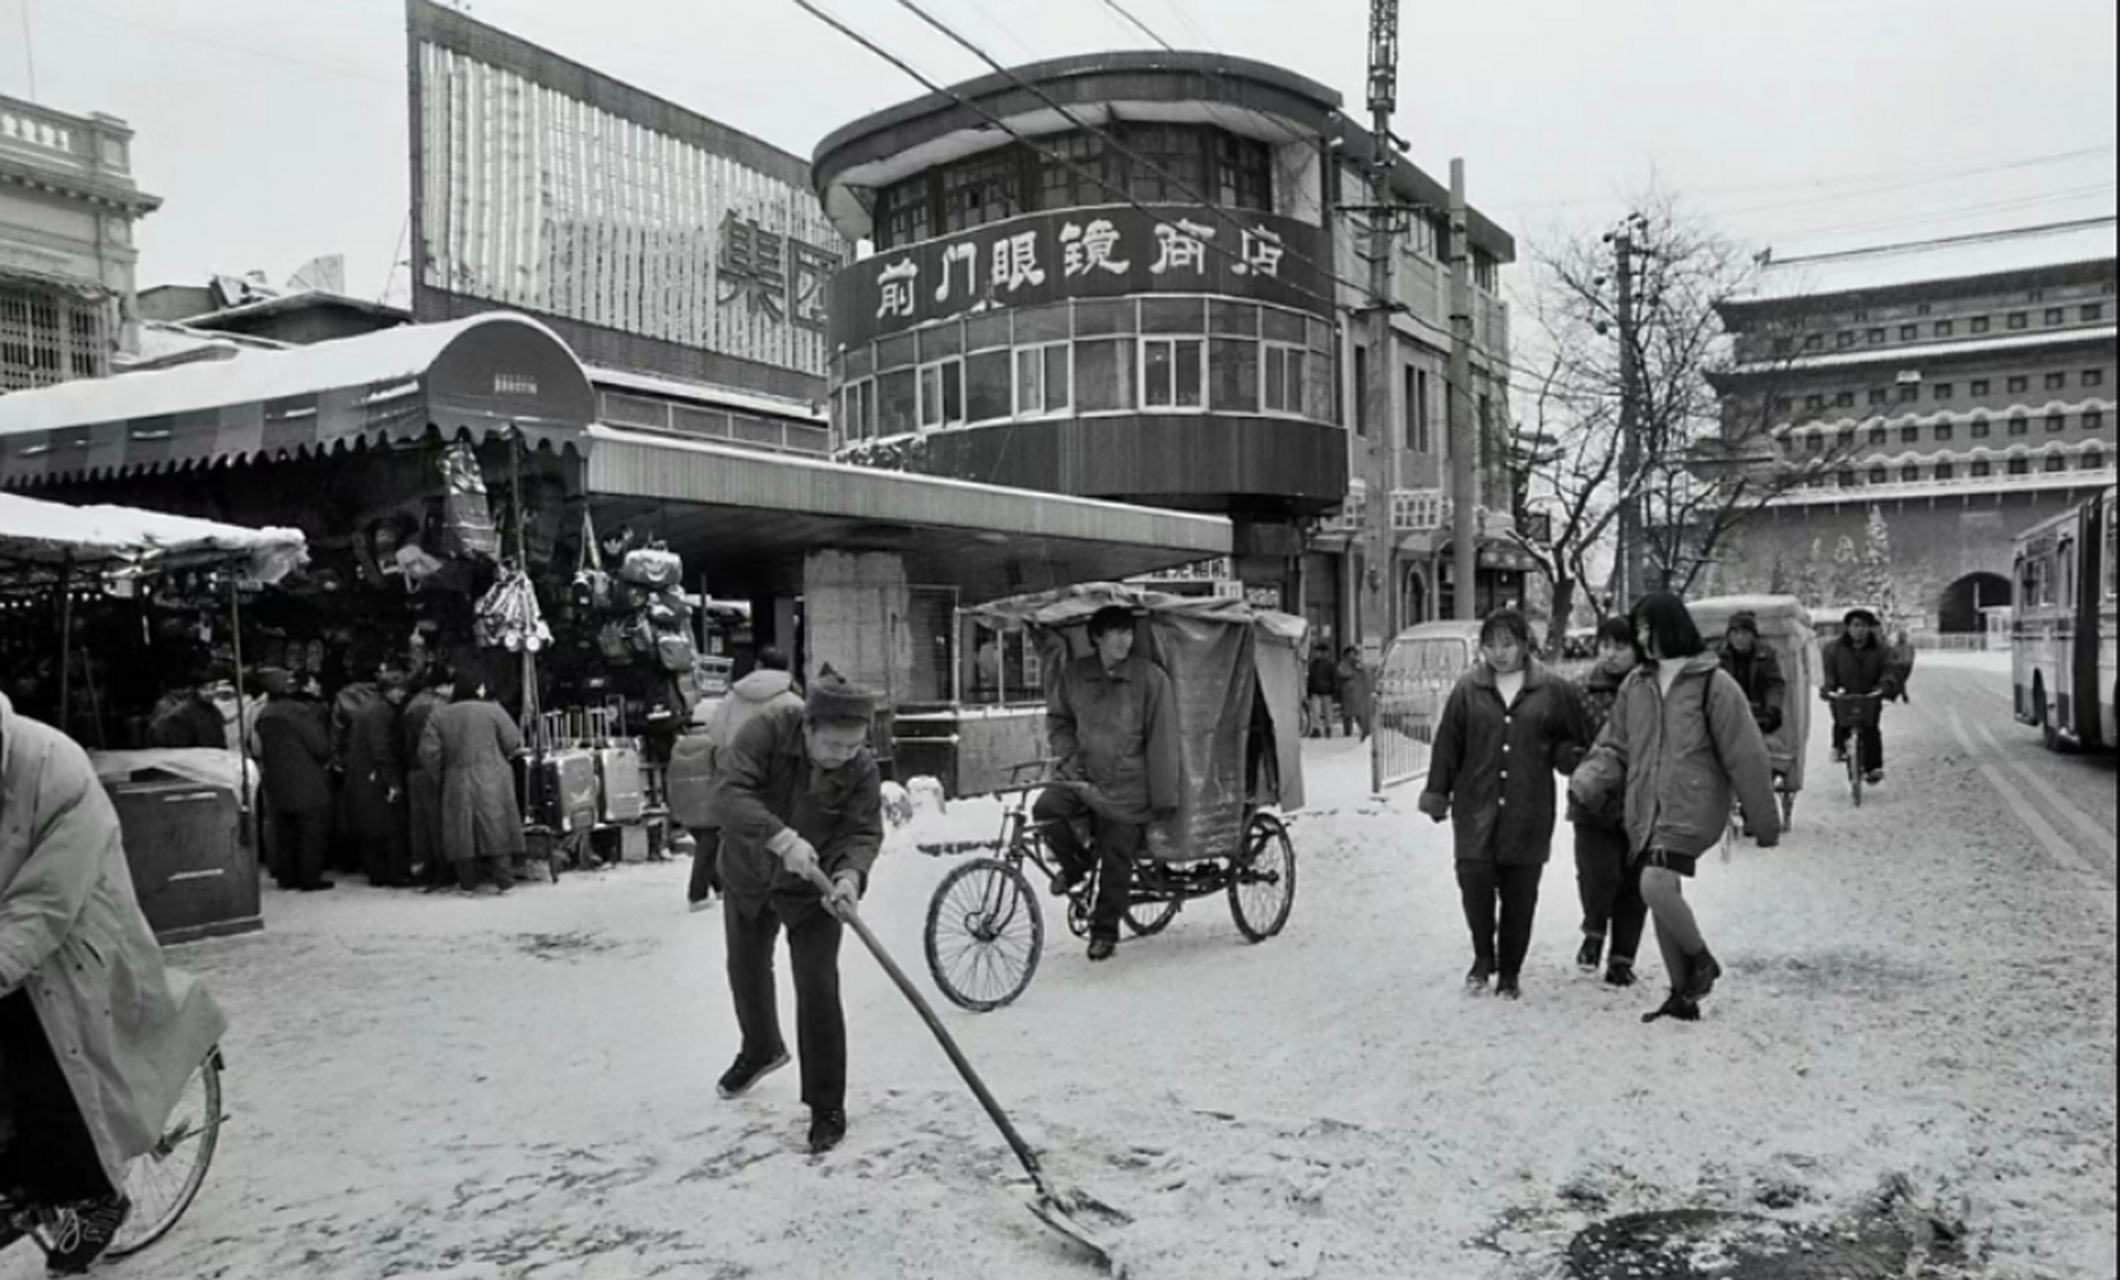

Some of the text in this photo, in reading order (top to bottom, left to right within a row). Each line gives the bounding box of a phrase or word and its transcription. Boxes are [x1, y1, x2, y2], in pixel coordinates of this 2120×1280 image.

[876, 218, 1284, 319] 前门眼镜商店
